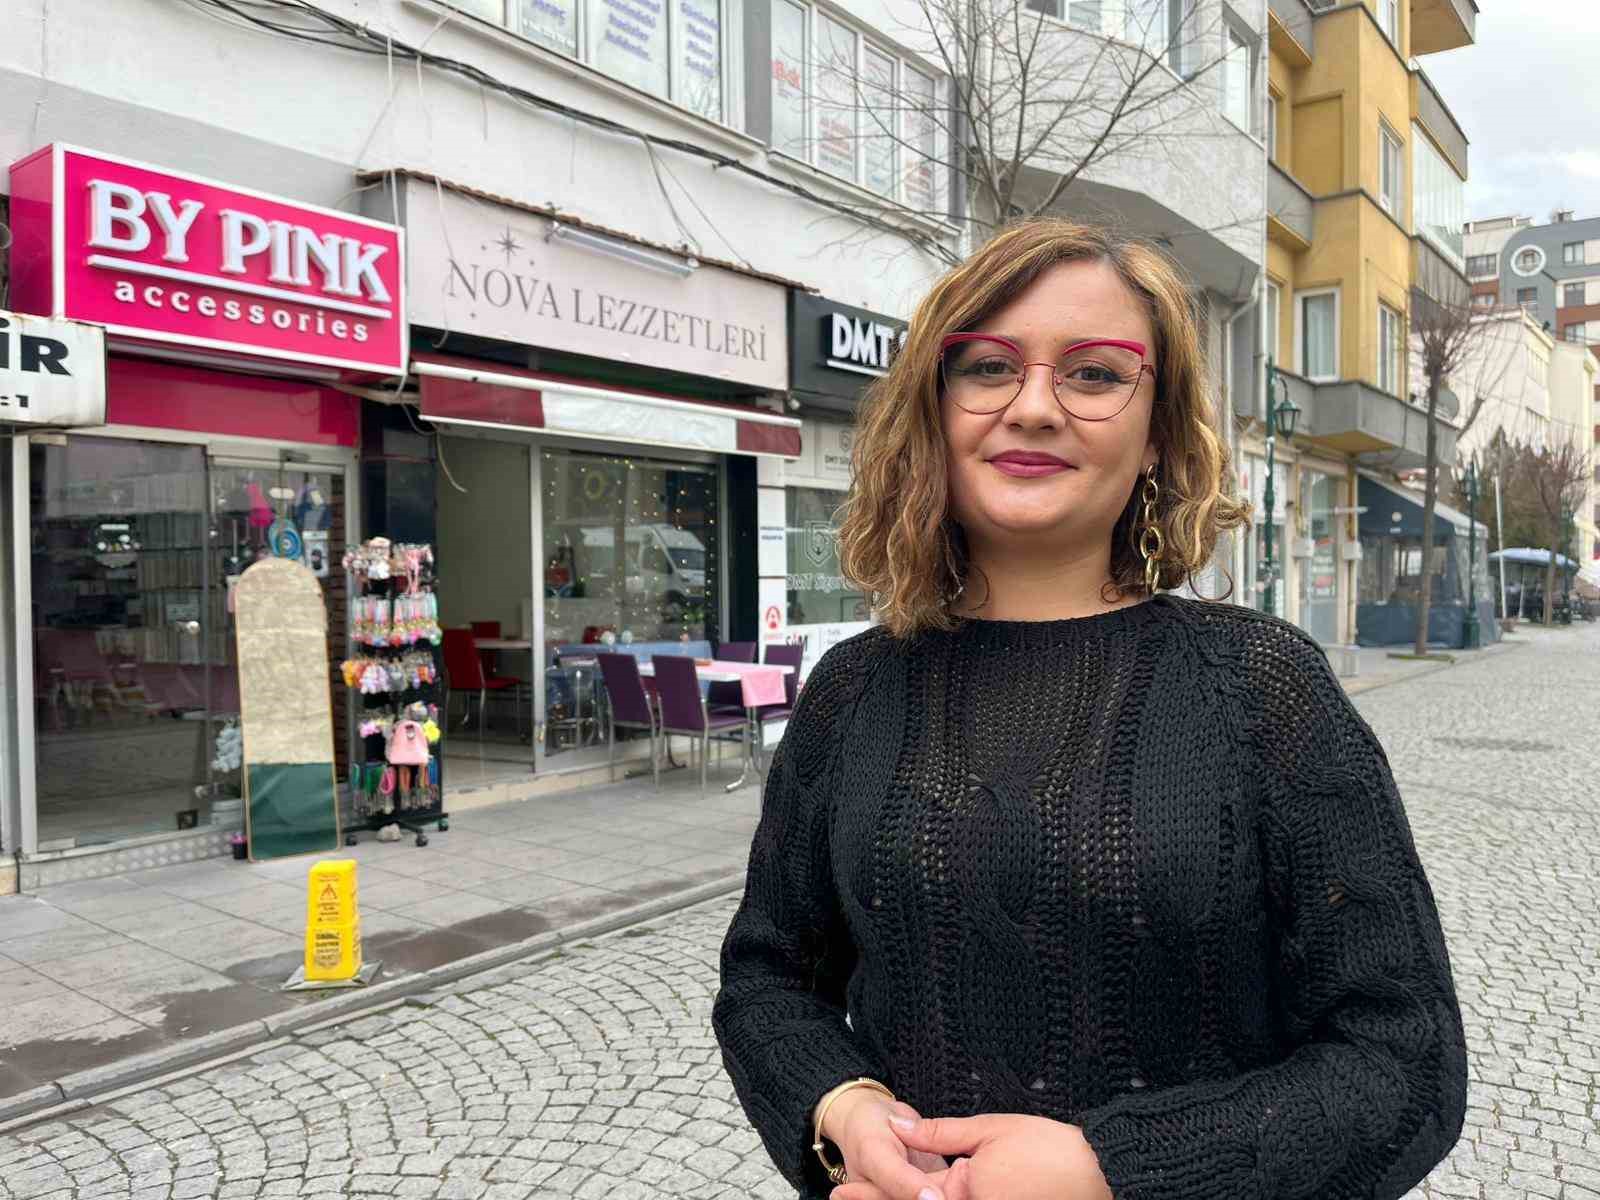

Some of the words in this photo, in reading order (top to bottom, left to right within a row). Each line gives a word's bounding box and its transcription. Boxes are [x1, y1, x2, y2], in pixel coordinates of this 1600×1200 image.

[87, 179, 203, 263] BY
[219, 208, 392, 304] PINK
[114, 279, 369, 342] accessories
[447, 258, 563, 321] NOVA
[571, 288, 768, 363] LEZZETLERİ
[831, 311, 894, 368] DMT
